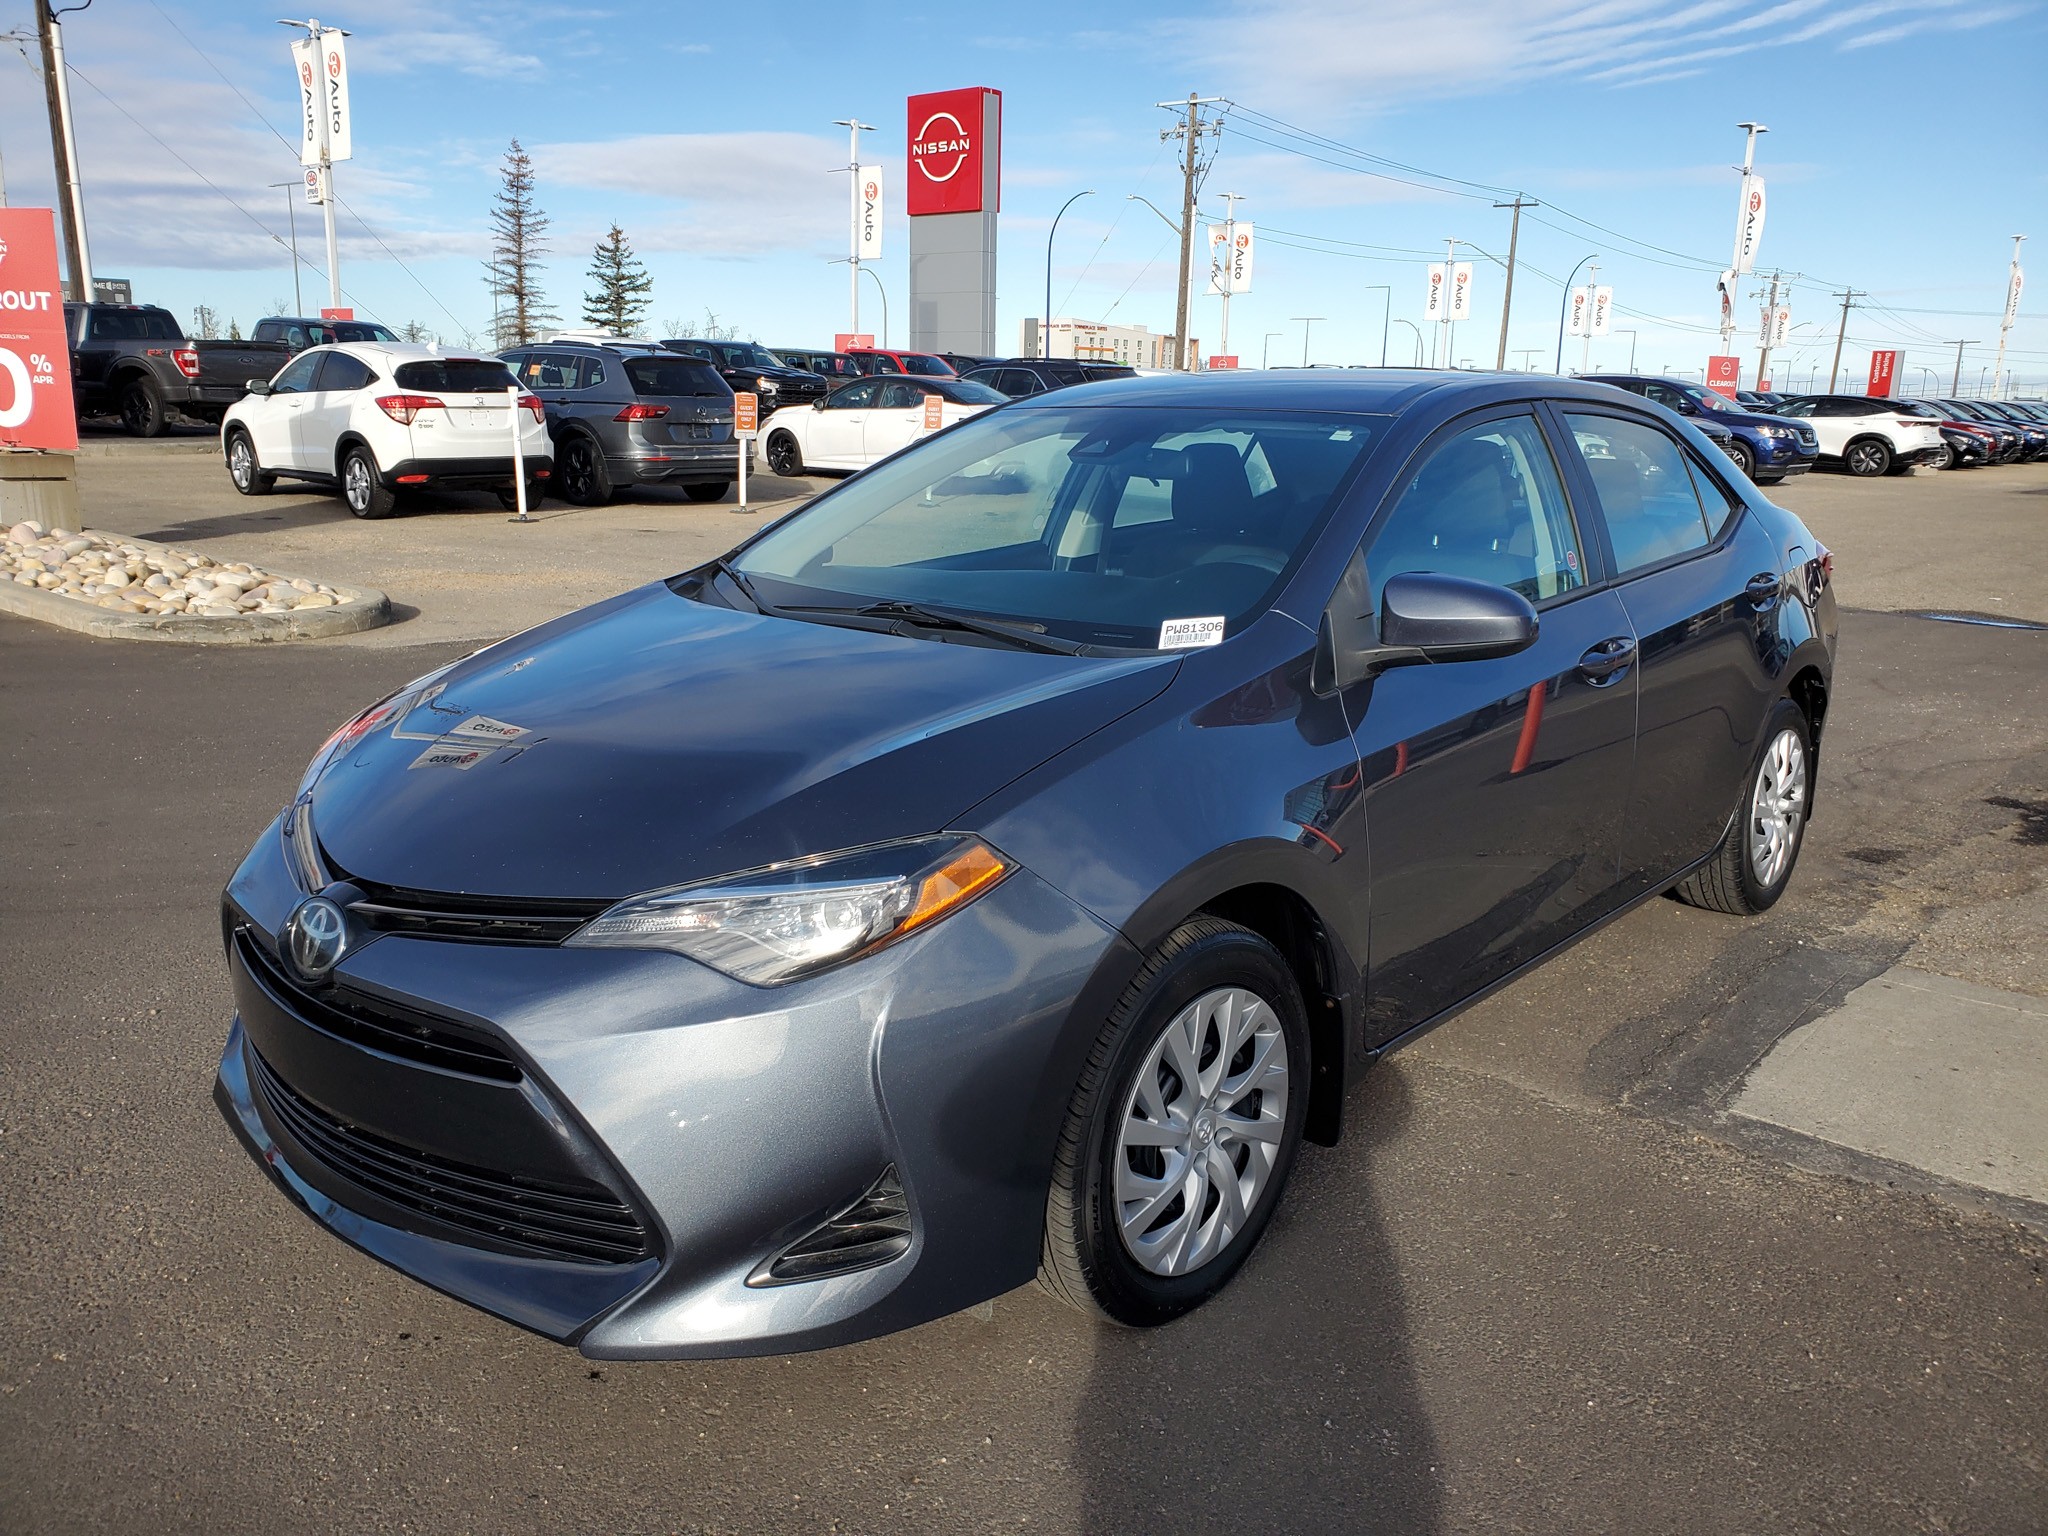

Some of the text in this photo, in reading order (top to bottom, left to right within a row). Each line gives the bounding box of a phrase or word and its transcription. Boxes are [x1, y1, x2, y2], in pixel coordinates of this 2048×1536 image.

[328, 52, 341, 134] go Auto
[305, 88, 314, 142] Auto
[913, 138, 970, 156] NISSAN
[864, 182, 878, 242] go Auto
[1743, 192, 1761, 256] go Auto
[1234, 248, 1244, 280] Auto
[1430, 285, 1438, 310] Auto
[1455, 284, 1463, 309] Auto
[1573, 305, 1581, 327] Auto
[29, 353, 52, 373] %
[1873, 353, 1882, 384] Customer
[1881, 352, 1892, 377] Parking
[33, 375, 54, 384] APR
[1709, 380, 1736, 388] CLEAROUT
[1165, 622, 1223, 635] PW81306
